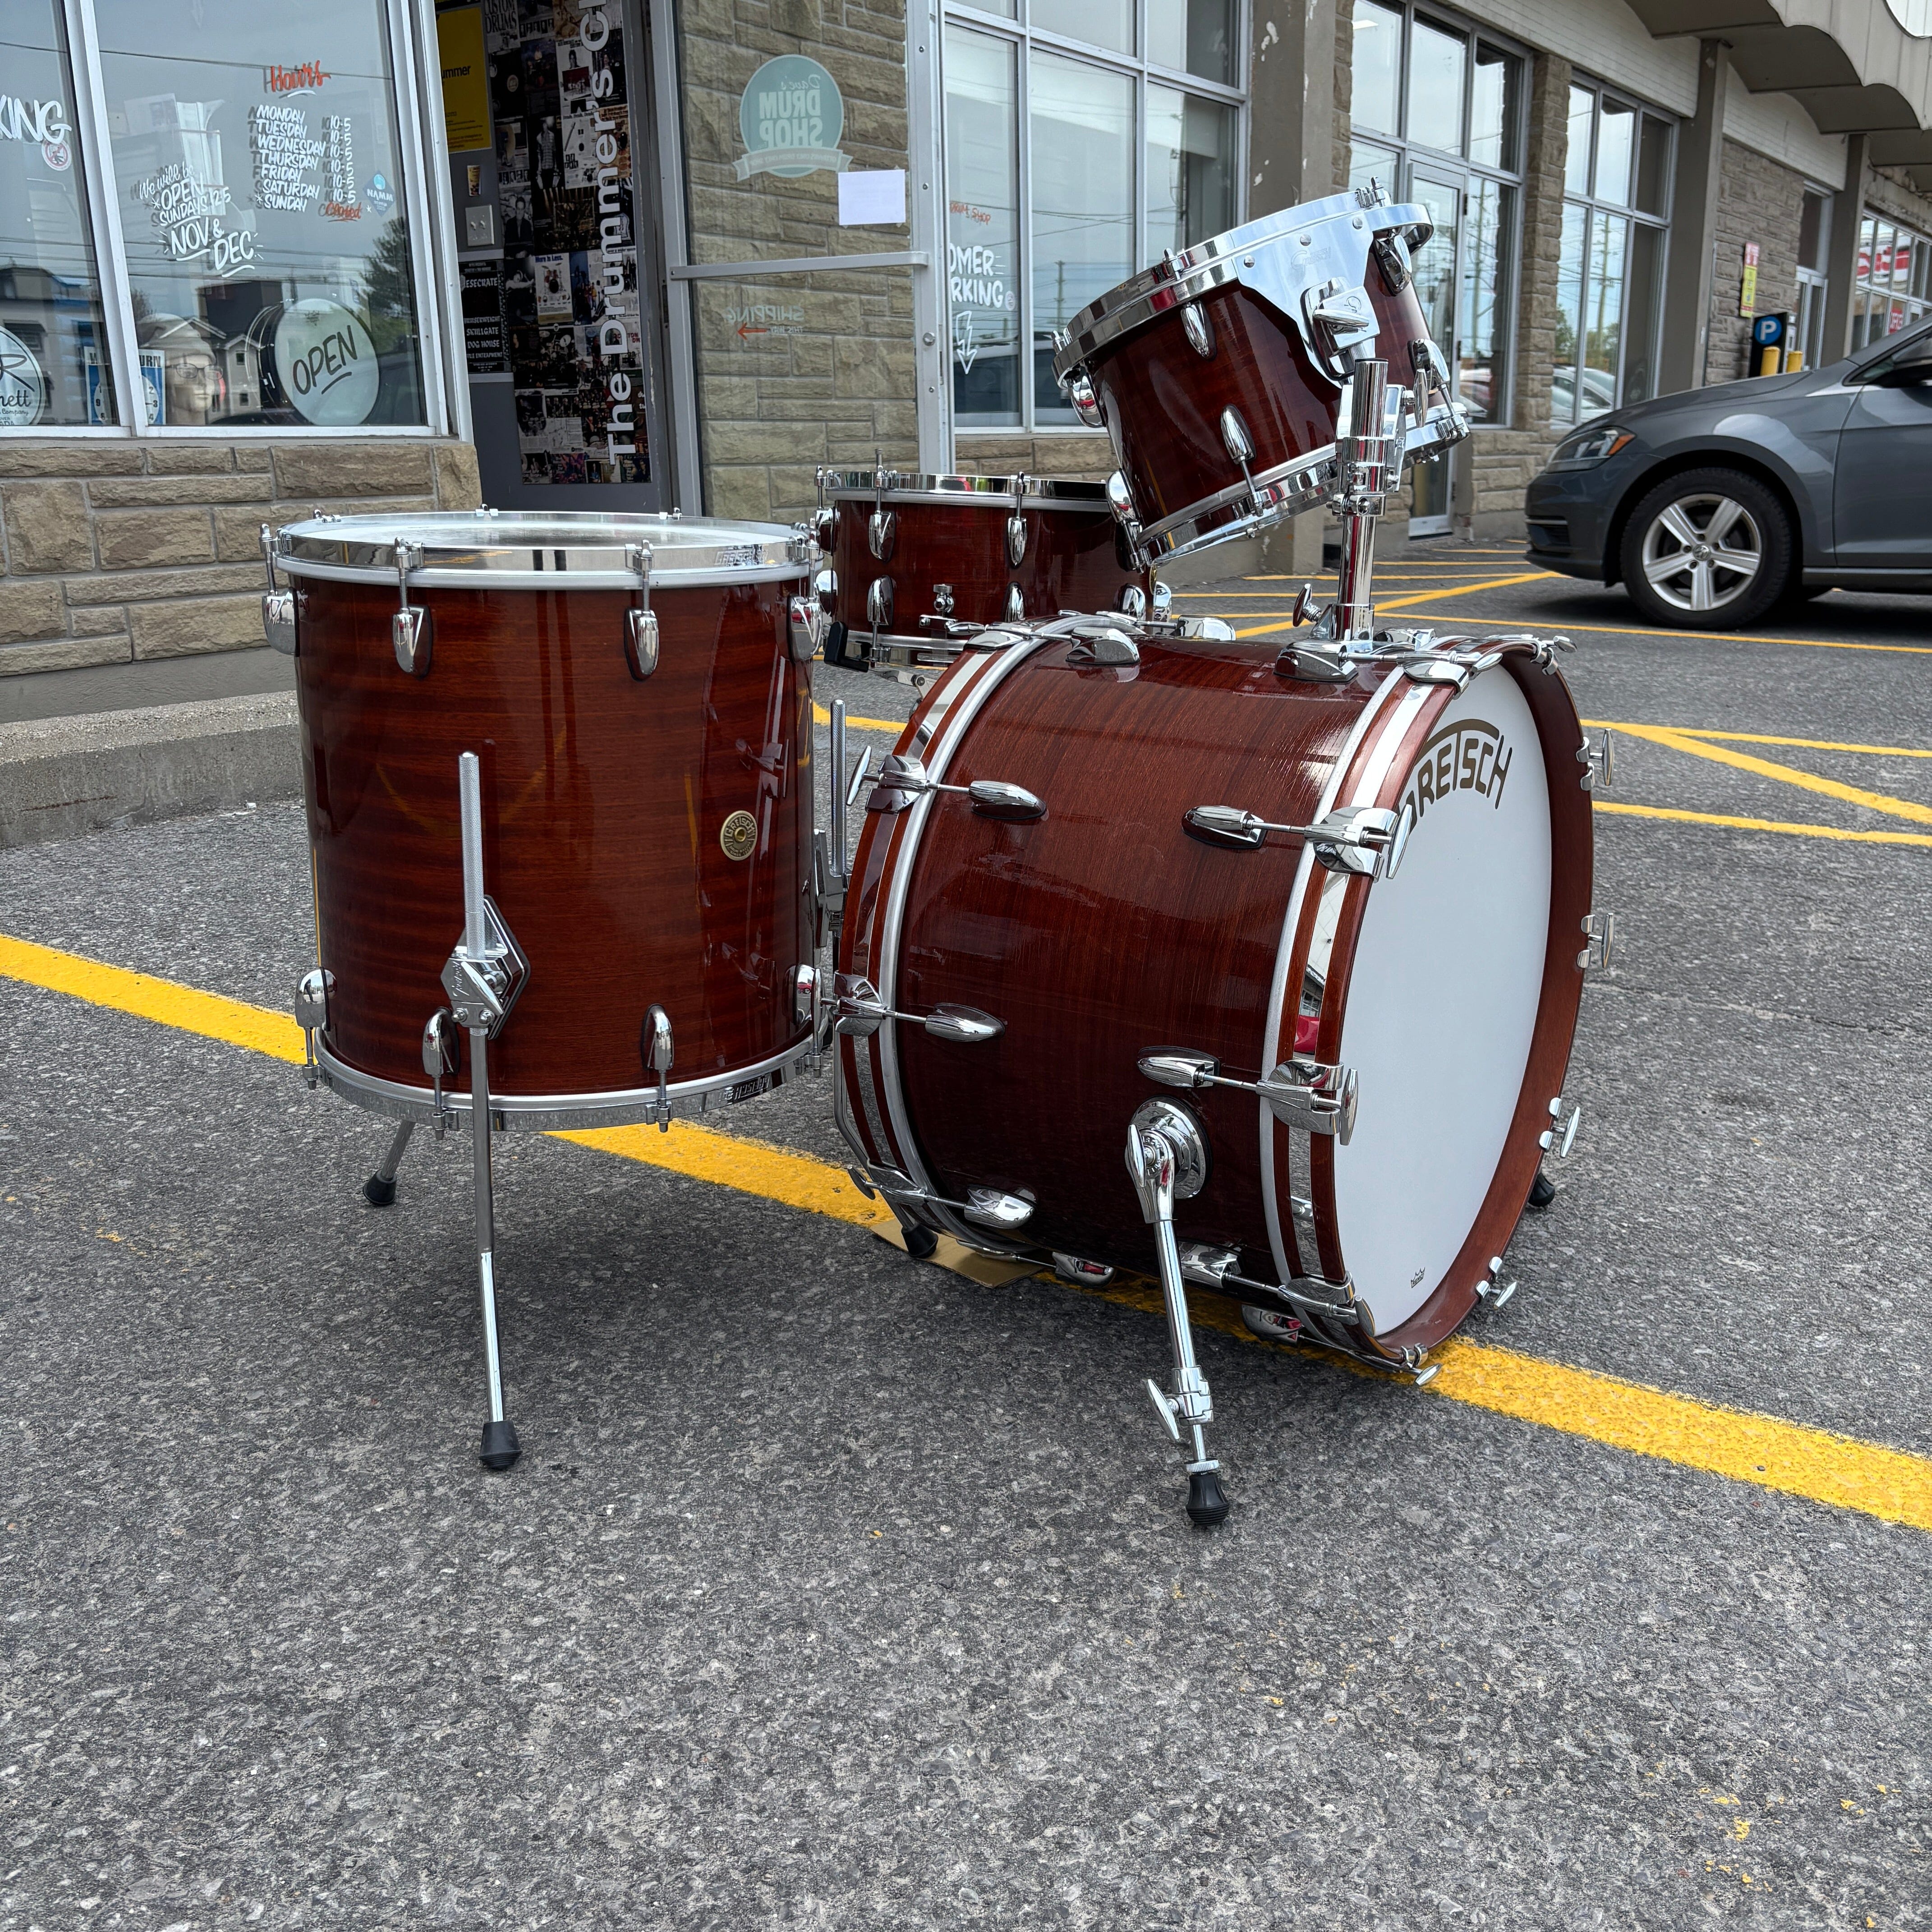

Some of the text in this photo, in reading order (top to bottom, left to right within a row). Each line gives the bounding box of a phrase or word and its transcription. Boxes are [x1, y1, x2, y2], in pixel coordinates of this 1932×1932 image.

[487, 11, 517, 33] DRUMS
[271, 60, 331, 92] Hours
[257, 105, 351, 131] MONDAY 10-5
[256, 119, 351, 146] TUESDAY 10-5
[258, 134, 352, 161] WEDNESDAY 10-5
[259, 149, 354, 176] THURSDAY 10-5
[139, 161, 194, 199] We will be
[261, 166, 354, 189] FRIDAY 10-5
[161, 172, 203, 210] OPEN
[262, 179, 356, 203] SATURDAY 10-5
[264, 194, 307, 212] SUNDAY
[367, 188, 393, 202] NAMM
[160, 195, 208, 226] SUNDAYS
[586, 69, 628, 355] Drummer's
[972, 208, 991, 225] SHOP
[466, 278, 497, 288] ESECRATE
[1760, 321, 1777, 340] P
[139, 355, 161, 367] URN
[293, 325, 358, 395] OPEN
[607, 373, 636, 465] The
